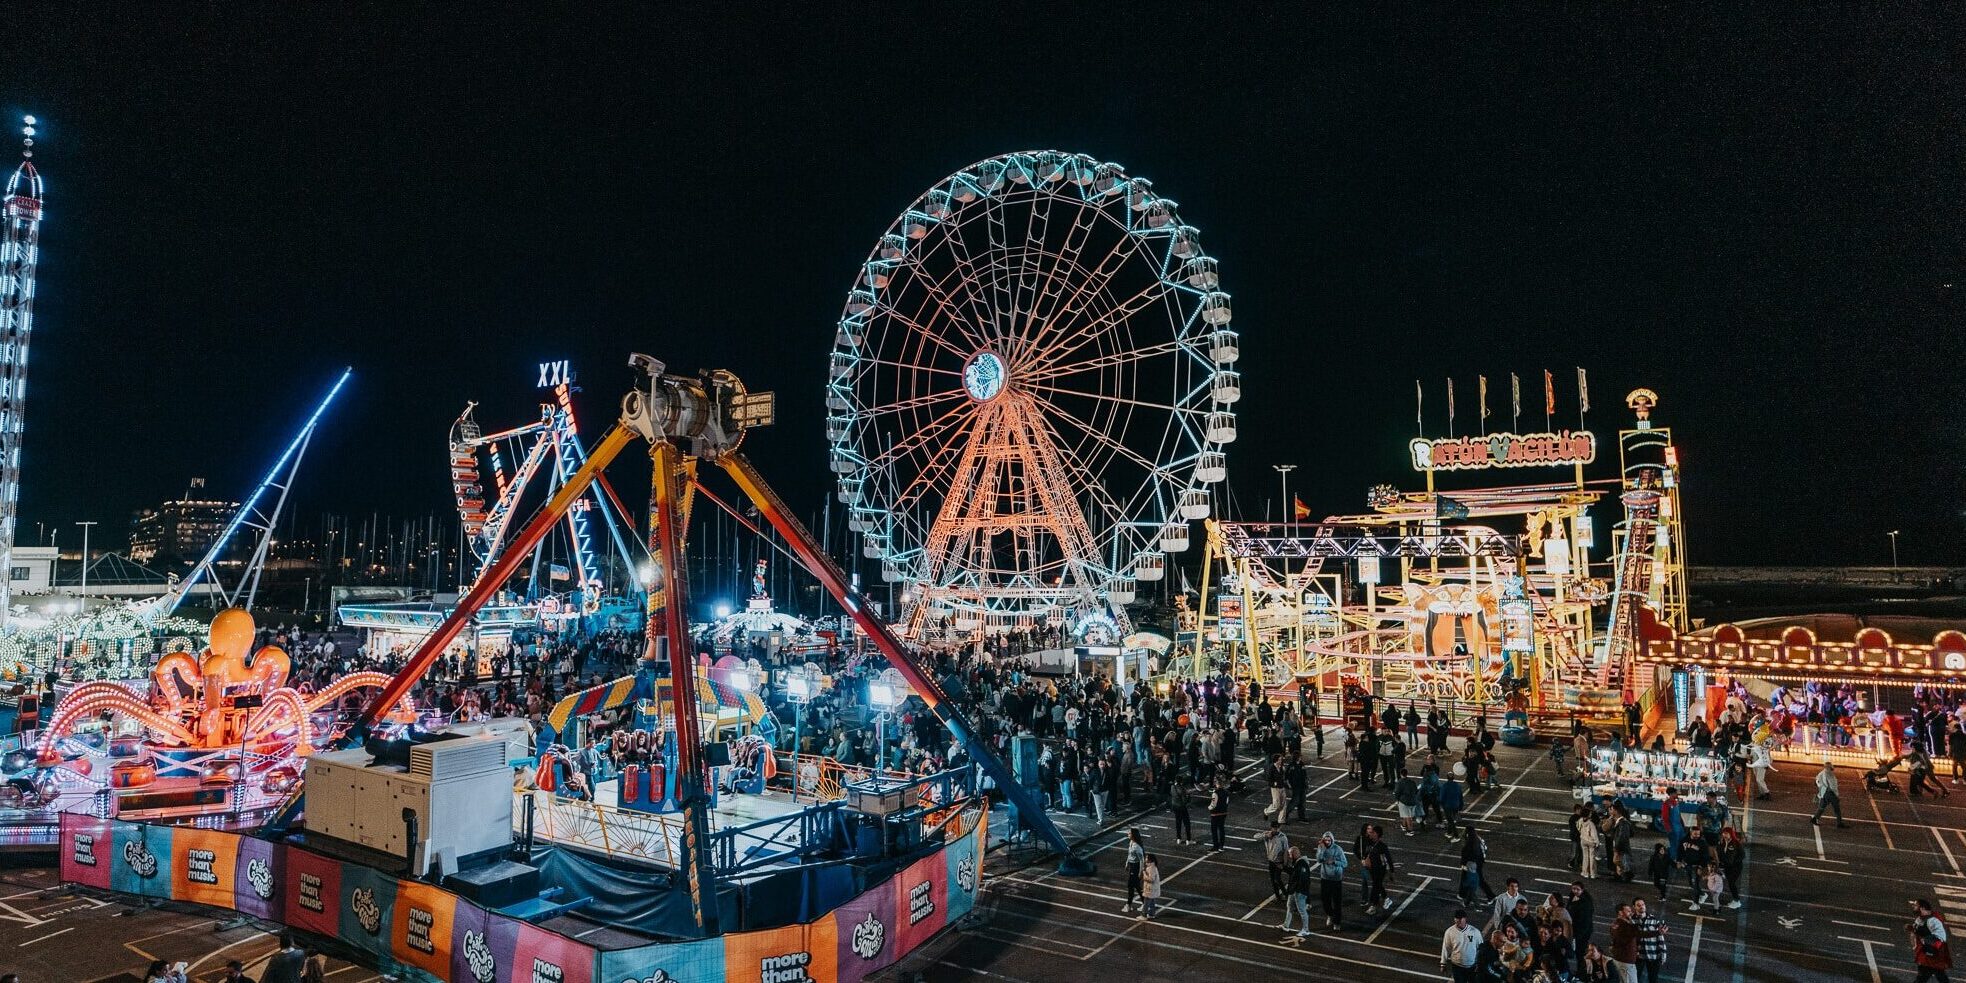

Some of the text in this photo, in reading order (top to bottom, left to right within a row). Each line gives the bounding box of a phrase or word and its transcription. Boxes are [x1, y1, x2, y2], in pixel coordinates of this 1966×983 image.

[537, 360, 570, 387] XXL
[74, 834, 92, 843] more
[75, 843, 91, 854] than
[189, 849, 213, 860] more
[74, 853, 96, 864] music
[188, 859, 210, 871] than
[188, 870, 216, 882] music
[301, 873, 321, 886] more
[300, 882, 318, 897] than
[911, 880, 930, 899] more
[299, 895, 323, 910] music
[911, 894, 929, 911] than
[409, 908, 432, 923] more
[911, 903, 934, 924] music
[408, 919, 428, 935] than
[407, 934, 432, 951] music
[534, 958, 562, 979] more
[761, 952, 808, 970] more
[761, 967, 804, 983] than
